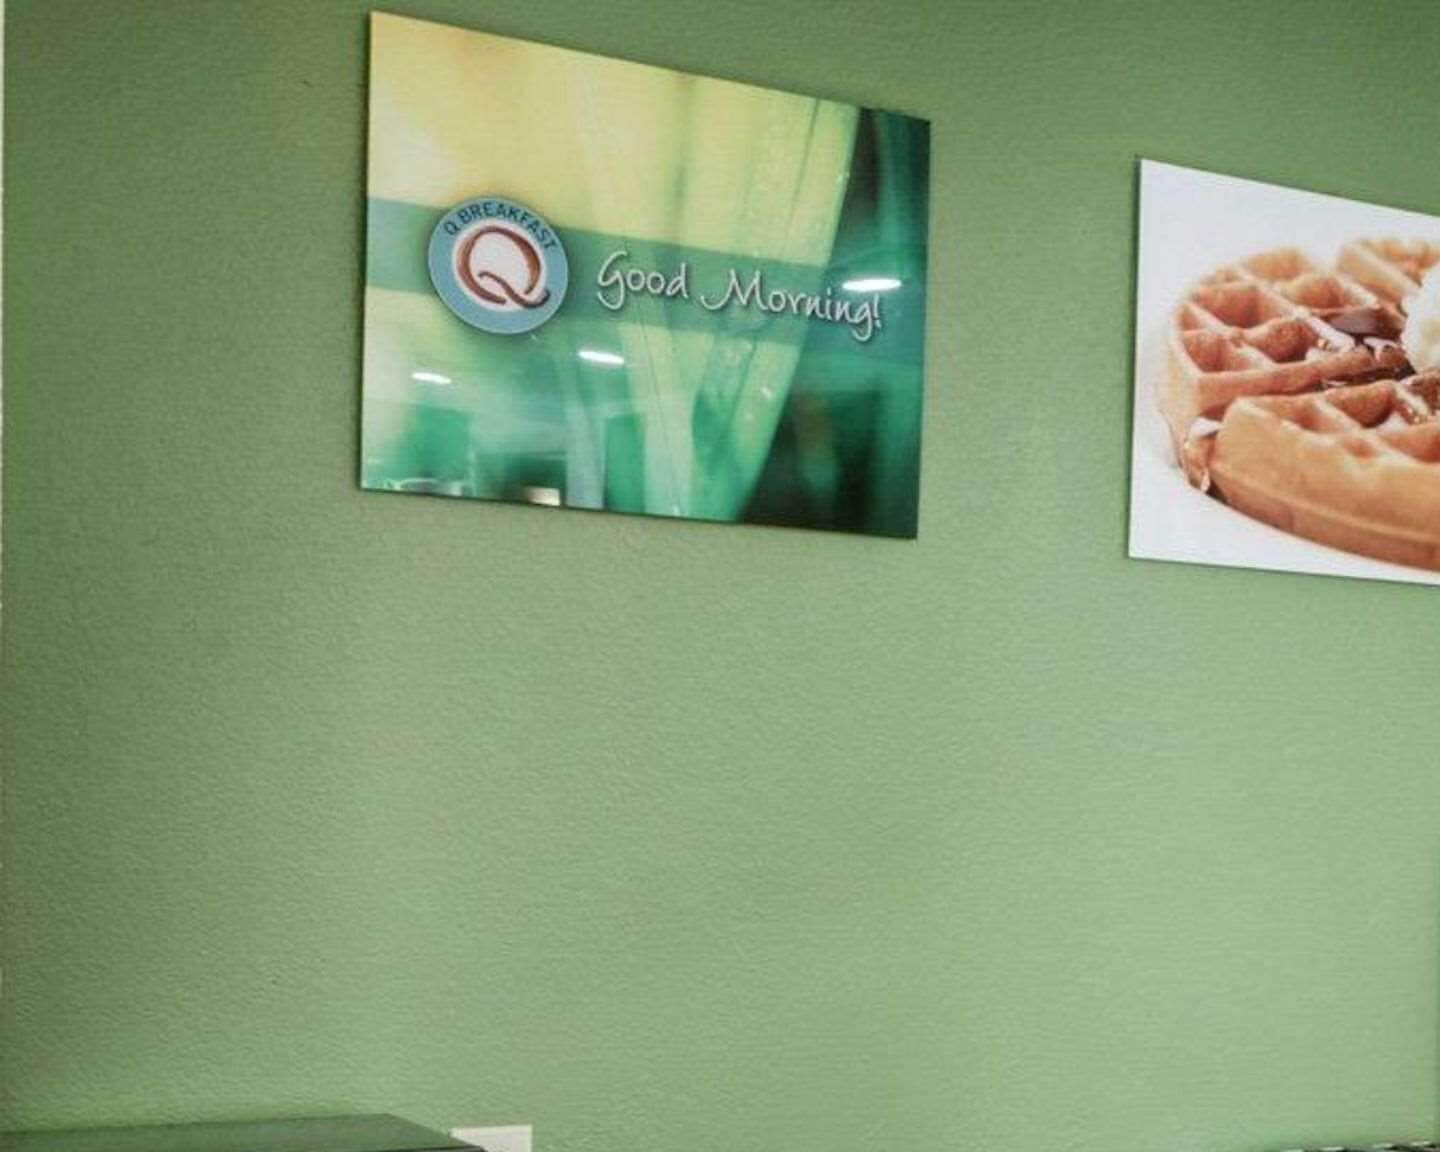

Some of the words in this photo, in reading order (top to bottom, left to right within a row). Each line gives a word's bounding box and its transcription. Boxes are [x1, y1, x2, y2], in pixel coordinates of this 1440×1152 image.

[443, 221, 462, 236] Q
[458, 202, 558, 249] BREAKFAST
[455, 224, 552, 310] Q
[597, 250, 689, 311] Good
[700, 268, 883, 342] Morning!
